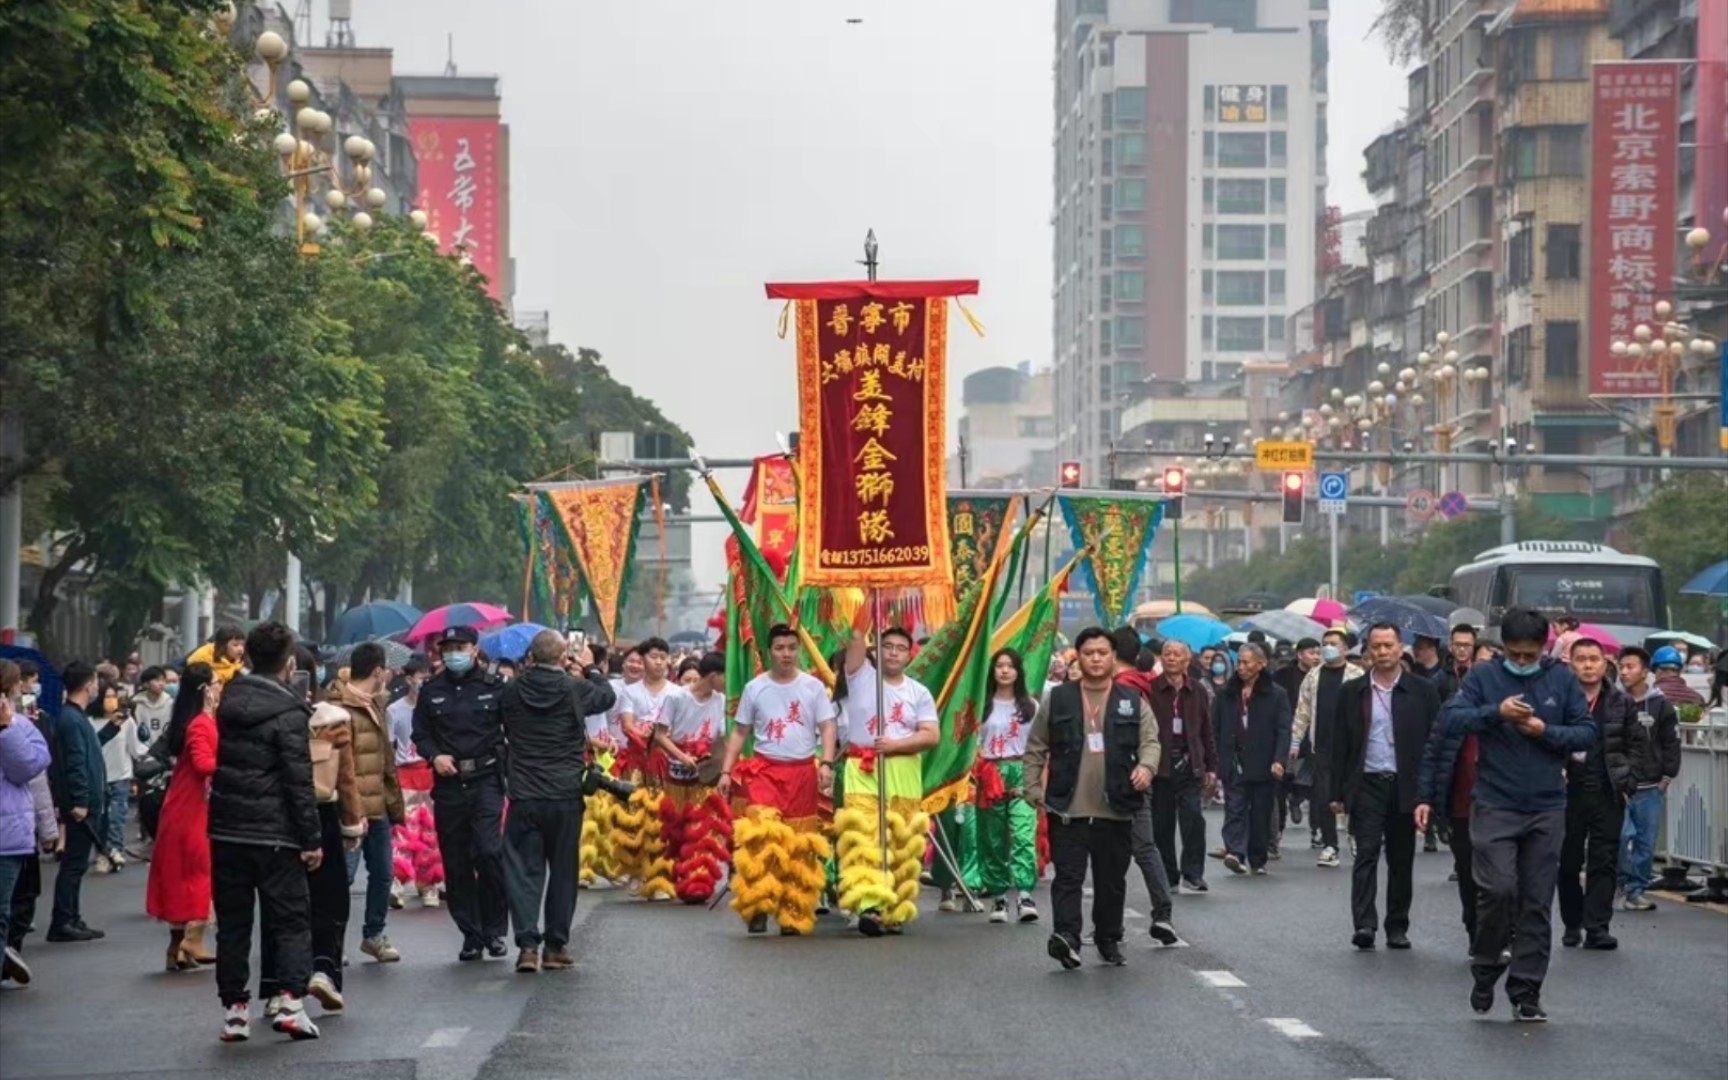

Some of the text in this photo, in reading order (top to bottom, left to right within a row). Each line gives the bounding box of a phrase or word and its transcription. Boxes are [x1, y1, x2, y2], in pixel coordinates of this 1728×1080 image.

[446, 138, 479, 252] 五常大
[1608, 103, 1660, 281] 北京索野商标
